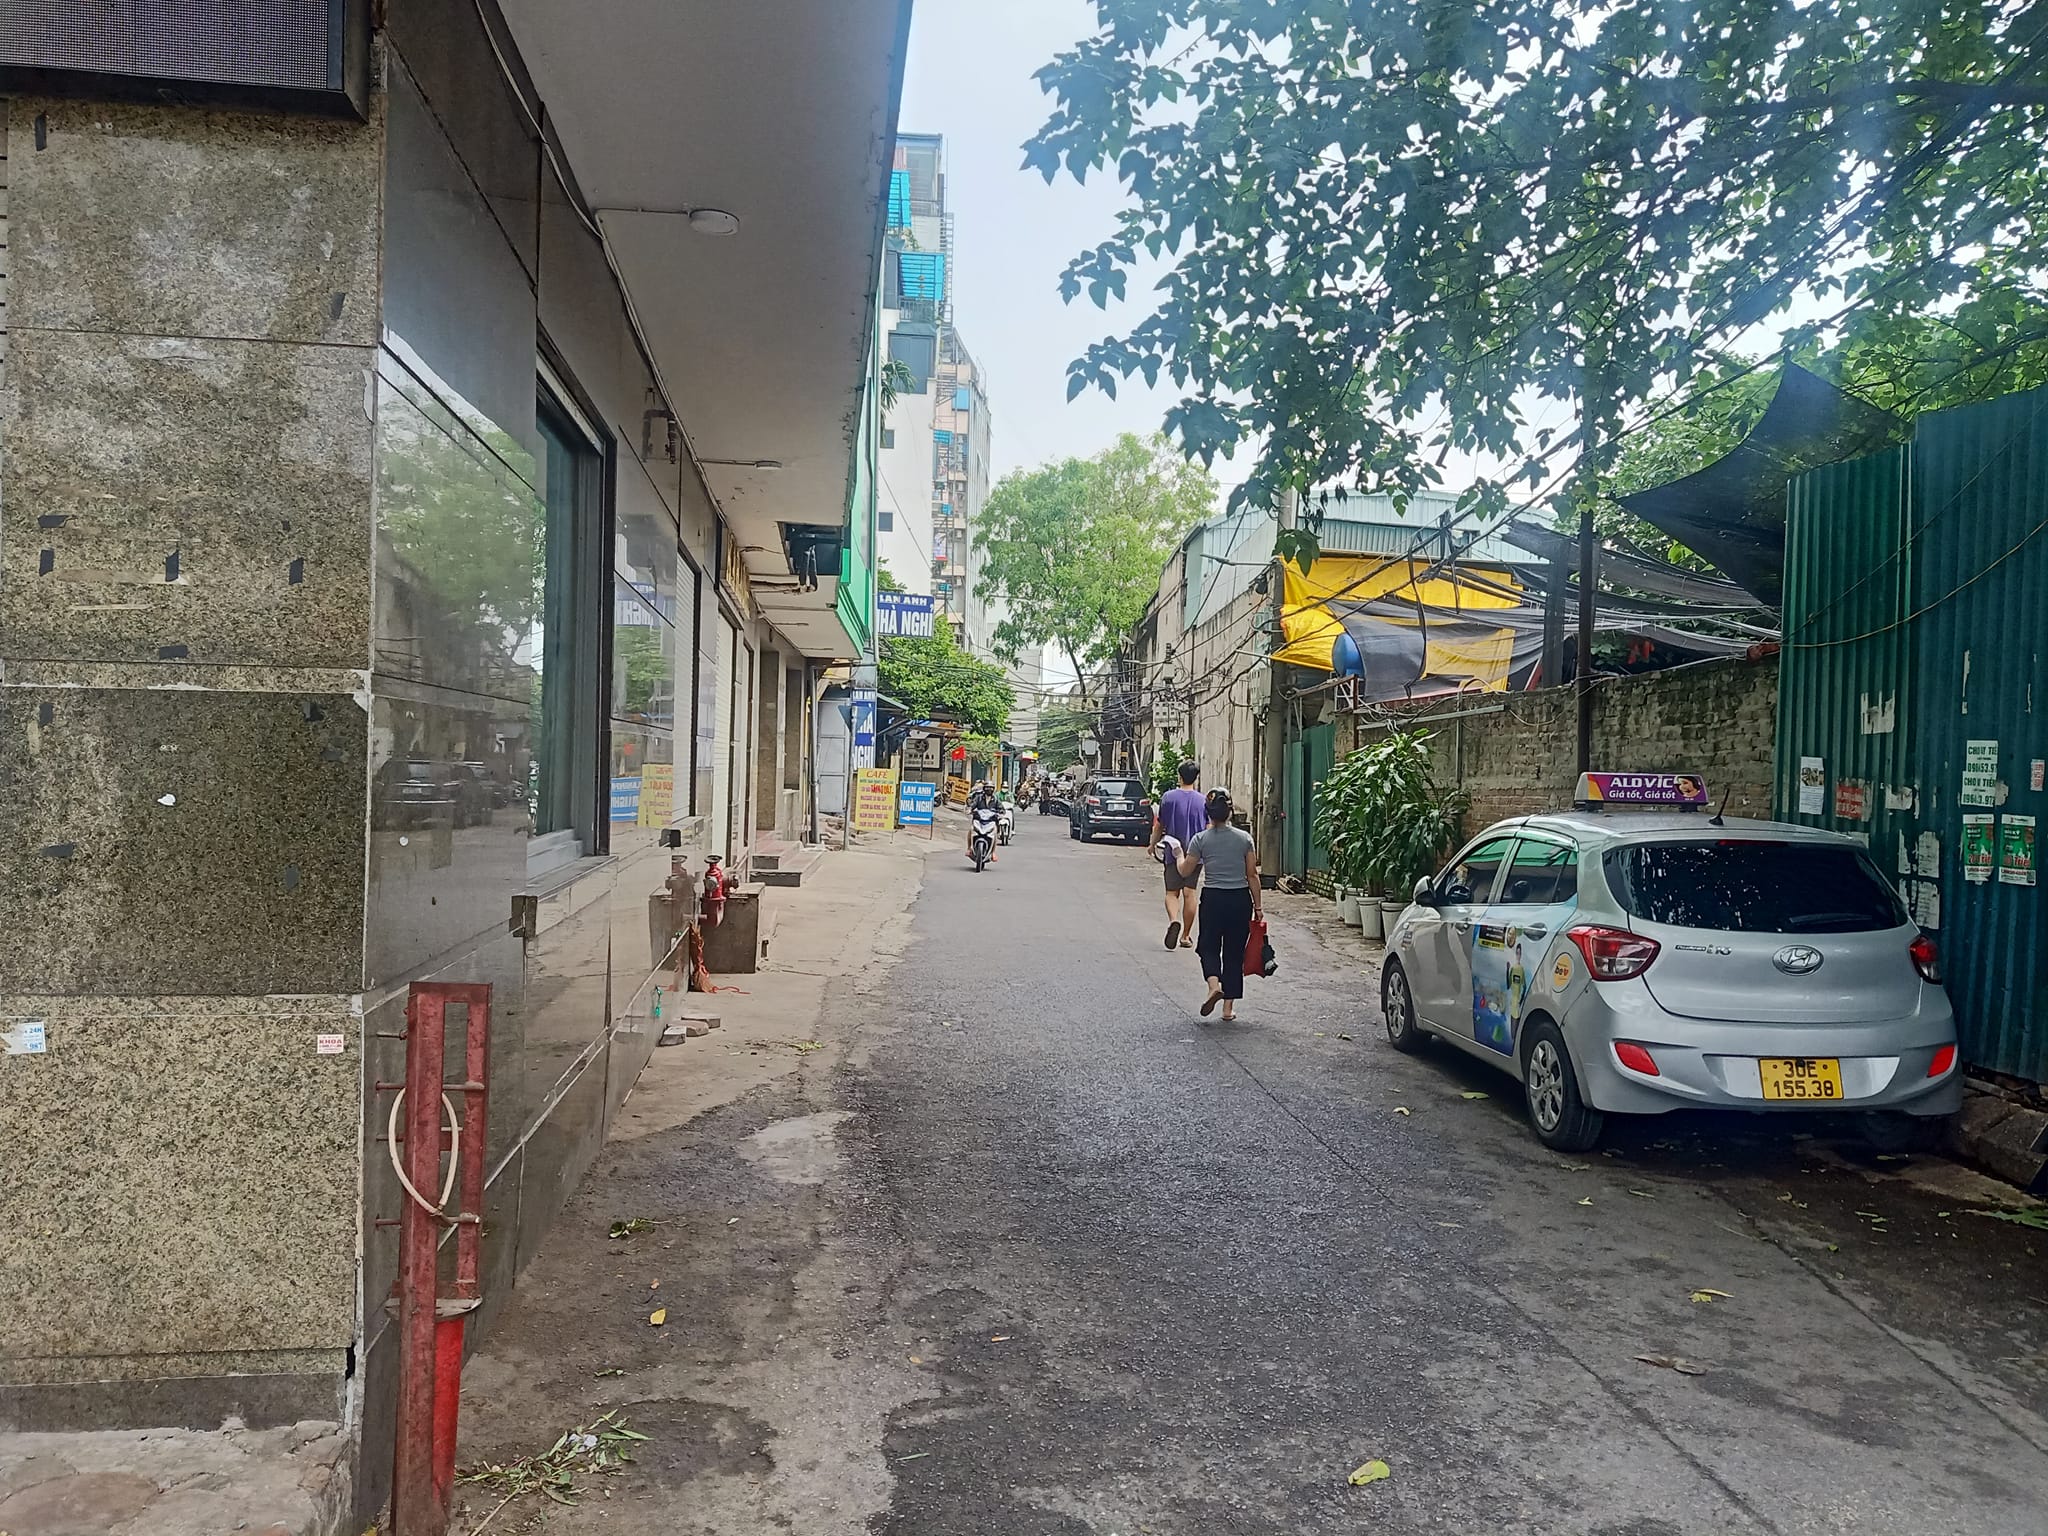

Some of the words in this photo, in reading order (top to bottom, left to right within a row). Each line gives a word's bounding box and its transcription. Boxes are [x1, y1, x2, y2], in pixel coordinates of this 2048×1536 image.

[903, 596, 927, 606] ANH
[903, 785, 916, 794] LAN
[917, 786, 932, 796] ANH
[1608, 790, 1624, 799] Giá
[1626, 789, 1642, 800] tốt,
[1644, 790, 1660, 799] Giá
[1662, 789, 1675, 800] tốt
[900, 798, 914, 812] NHÀ
[1783, 1061, 1818, 1078] 30E
[1773, 1080, 1834, 1098] 155.38
